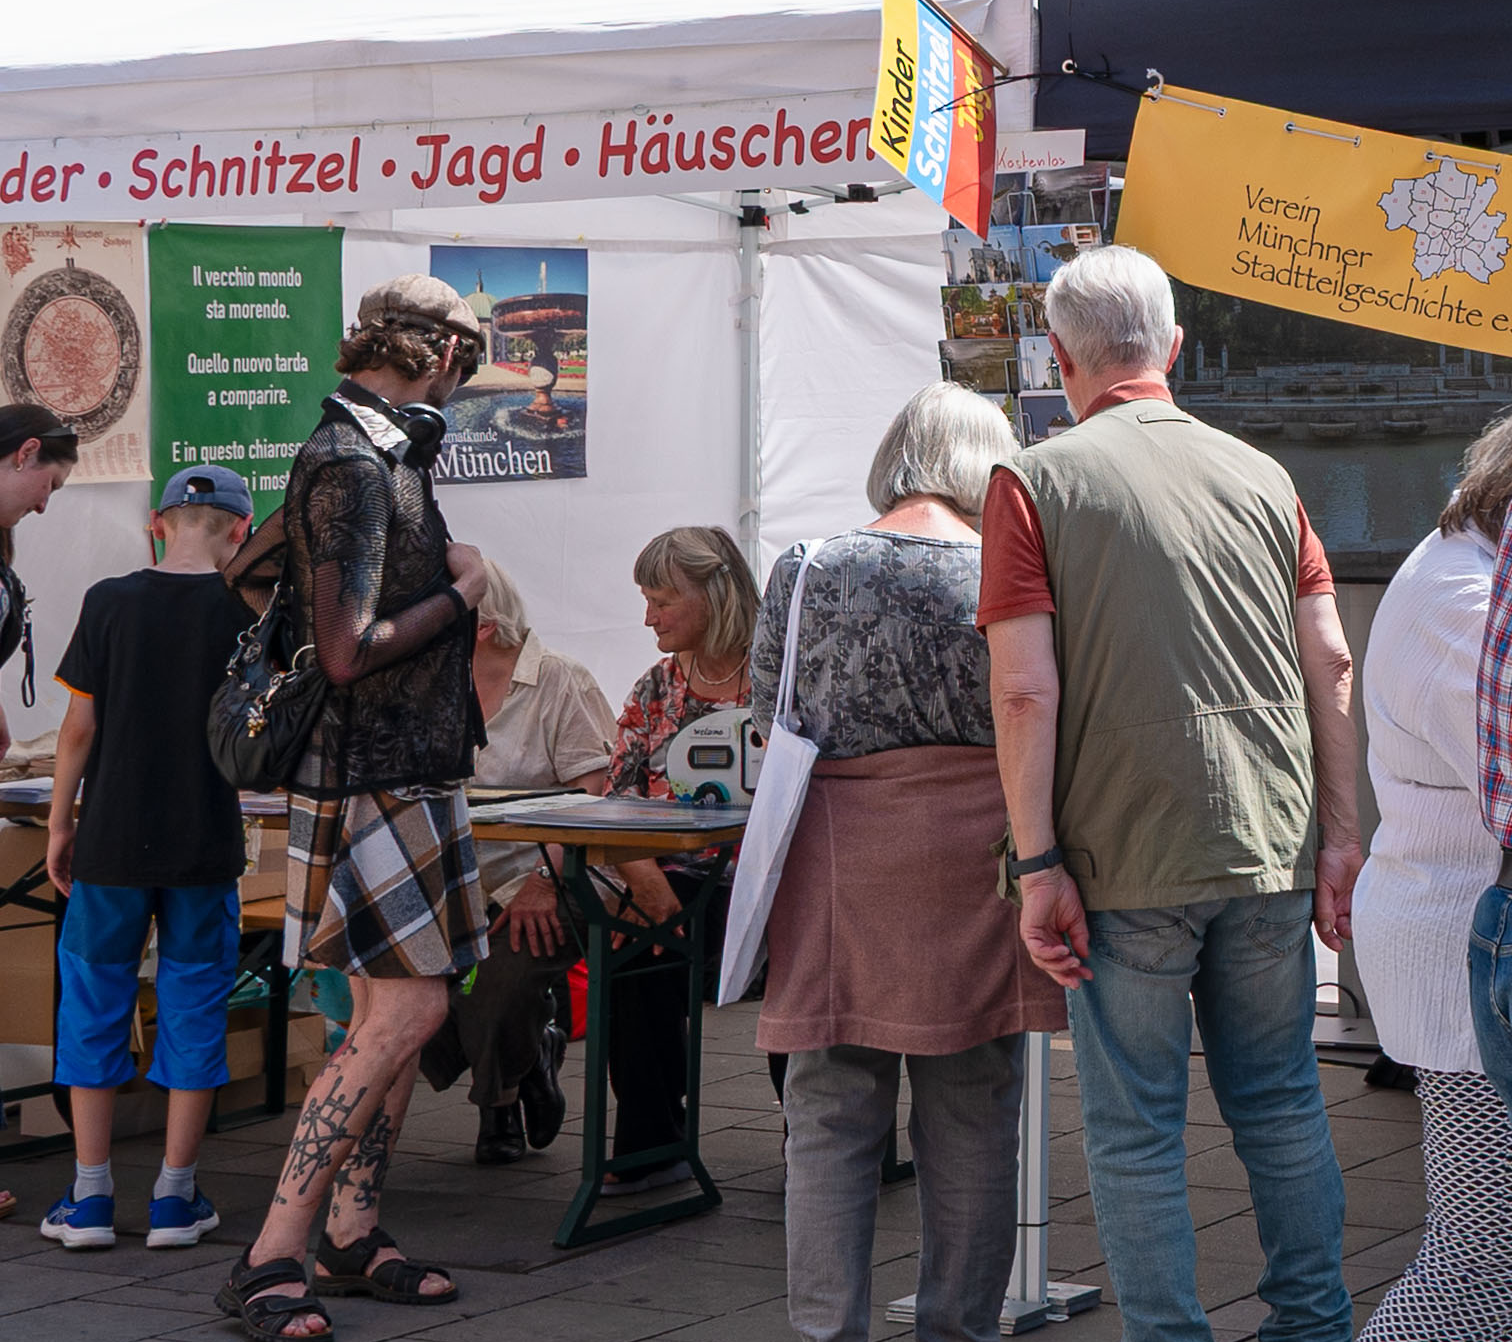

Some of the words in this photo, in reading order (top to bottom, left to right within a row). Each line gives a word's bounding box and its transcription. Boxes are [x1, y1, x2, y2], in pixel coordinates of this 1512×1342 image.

[881, 37, 915, 158] Kinder
[916, 20, 951, 187] Schnitzel
[956, 49, 992, 142] Jagd
[128, 136, 361, 200] Schnitzel
[411, 124, 545, 203] Jagd
[599, 108, 876, 177] Häuschen
[996, 147, 1066, 170] Kostenlos
[1246, 185, 1321, 225] Verein
[1238, 217, 1373, 268] Münchner
[193, 265, 202, 286] Il
[205, 266, 255, 287] vecchio
[258, 267, 302, 287] mondo
[1231, 250, 1483, 327] Stadtteilgeschichte
[206, 300, 225, 319] sta
[229, 299, 290, 320] morendo.
[188, 353, 229, 373] Quello
[233, 357, 272, 373] nuovo
[275, 353, 309, 372] tarda
[208, 390, 216, 406] a
[220, 385, 291, 410] comparire.
[172, 442, 180, 462] E
[185, 441, 197, 461] in
[200, 442, 244, 464] questo
[434, 440, 553, 478] München
